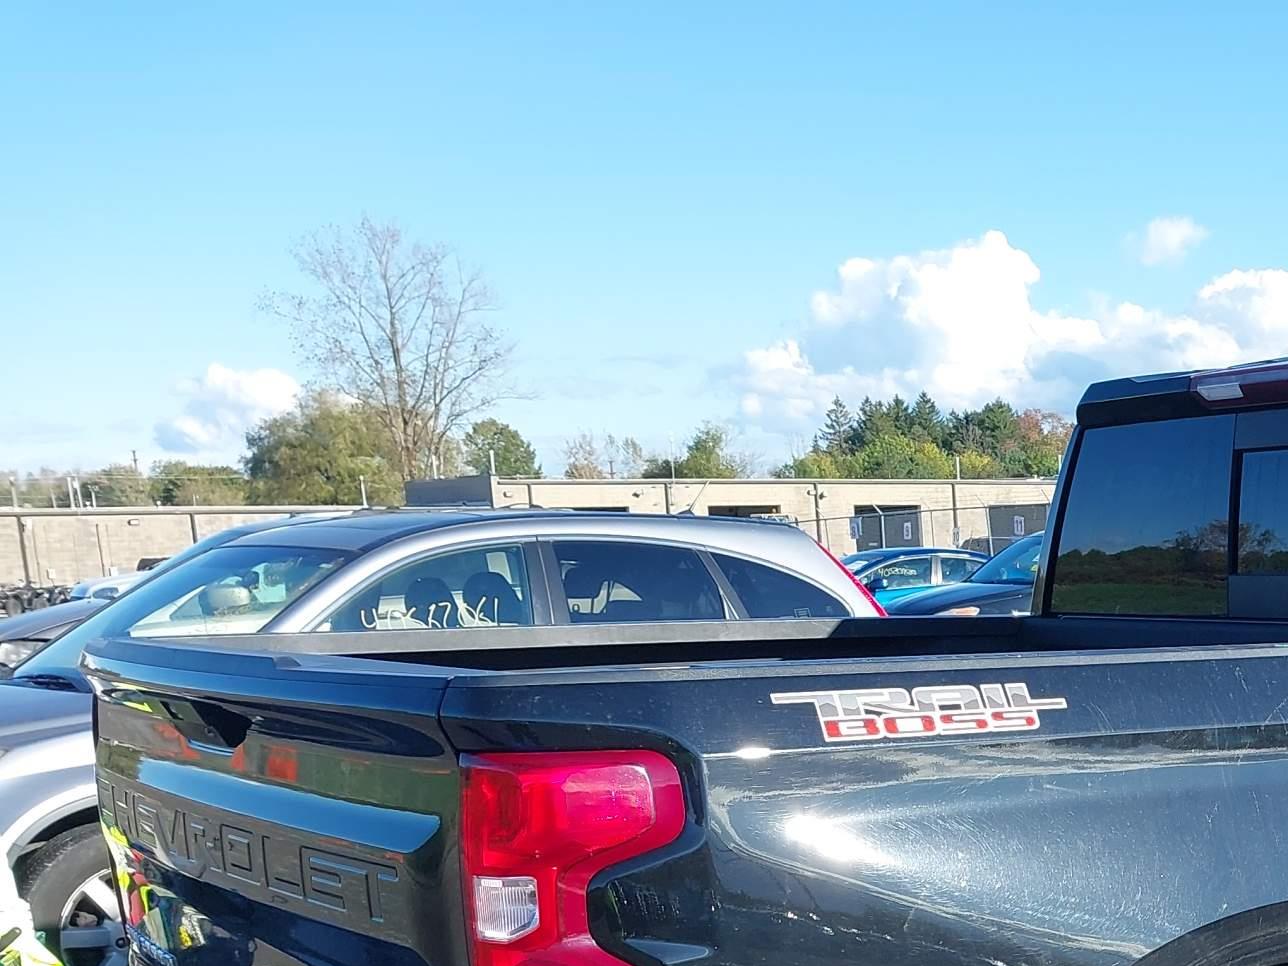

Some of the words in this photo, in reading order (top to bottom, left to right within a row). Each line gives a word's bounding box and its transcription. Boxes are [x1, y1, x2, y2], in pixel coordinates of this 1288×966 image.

[770, 682, 1068, 720] TRAIL
[822, 708, 1041, 742] BOSS
[96, 776, 399, 923] CHEVROLET
